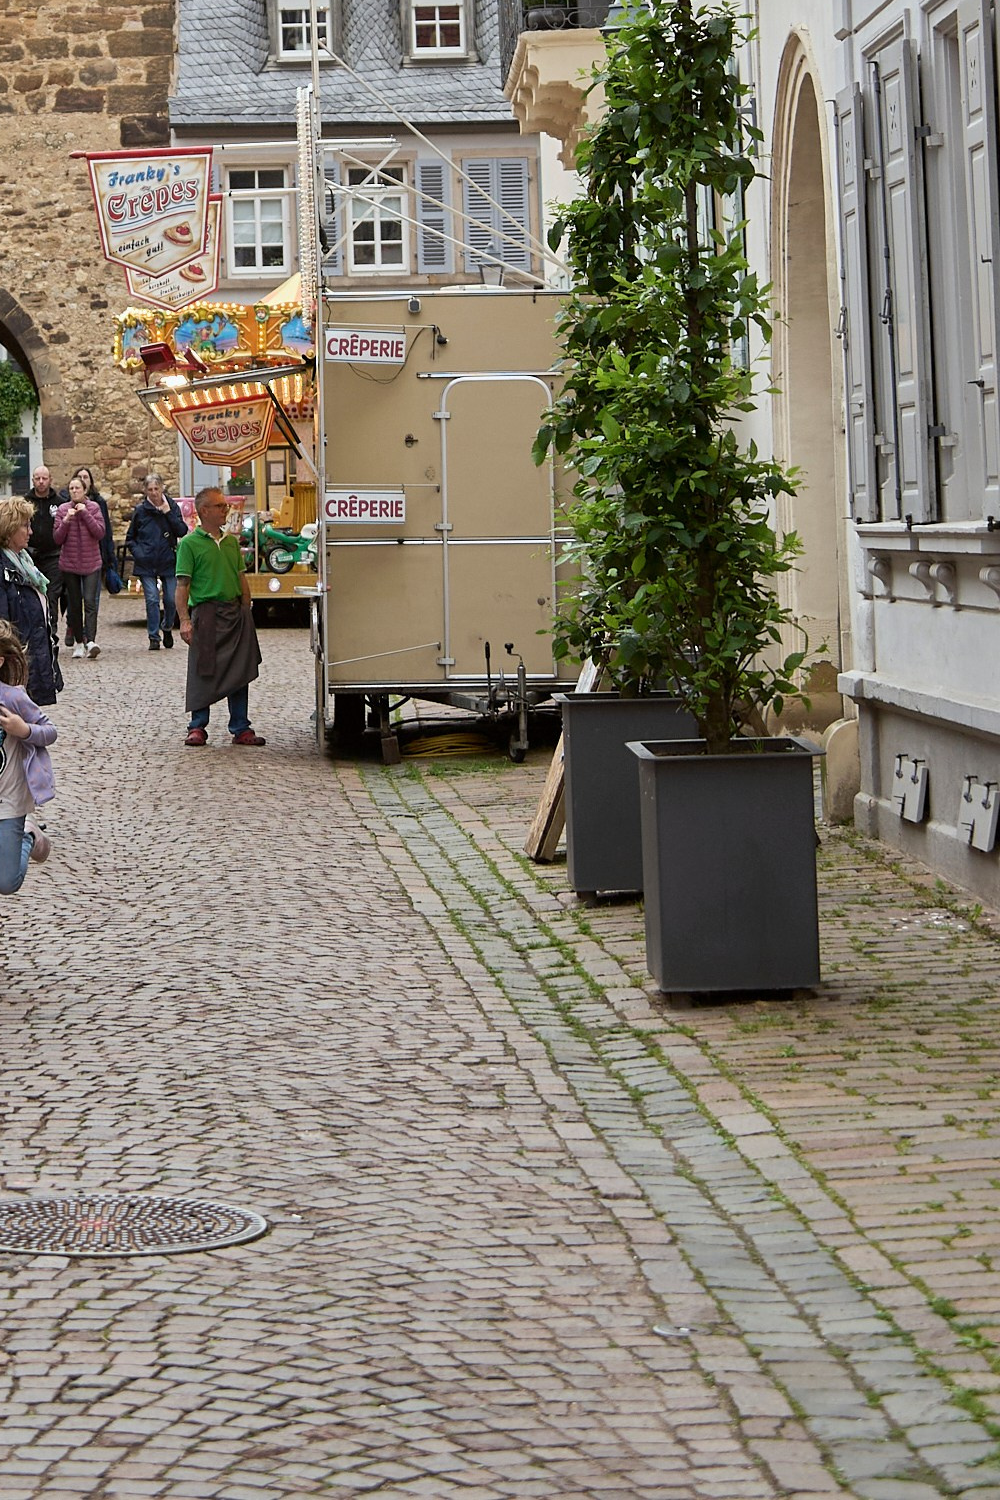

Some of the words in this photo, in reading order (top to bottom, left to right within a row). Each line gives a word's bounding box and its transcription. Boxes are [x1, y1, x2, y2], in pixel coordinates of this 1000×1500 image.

[107, 179, 198, 222] Crêpes
[146, 242, 164, 257] gut!
[327, 333, 404, 358] CRÊPERIE
[325, 495, 404, 518] CRÊPERIE
